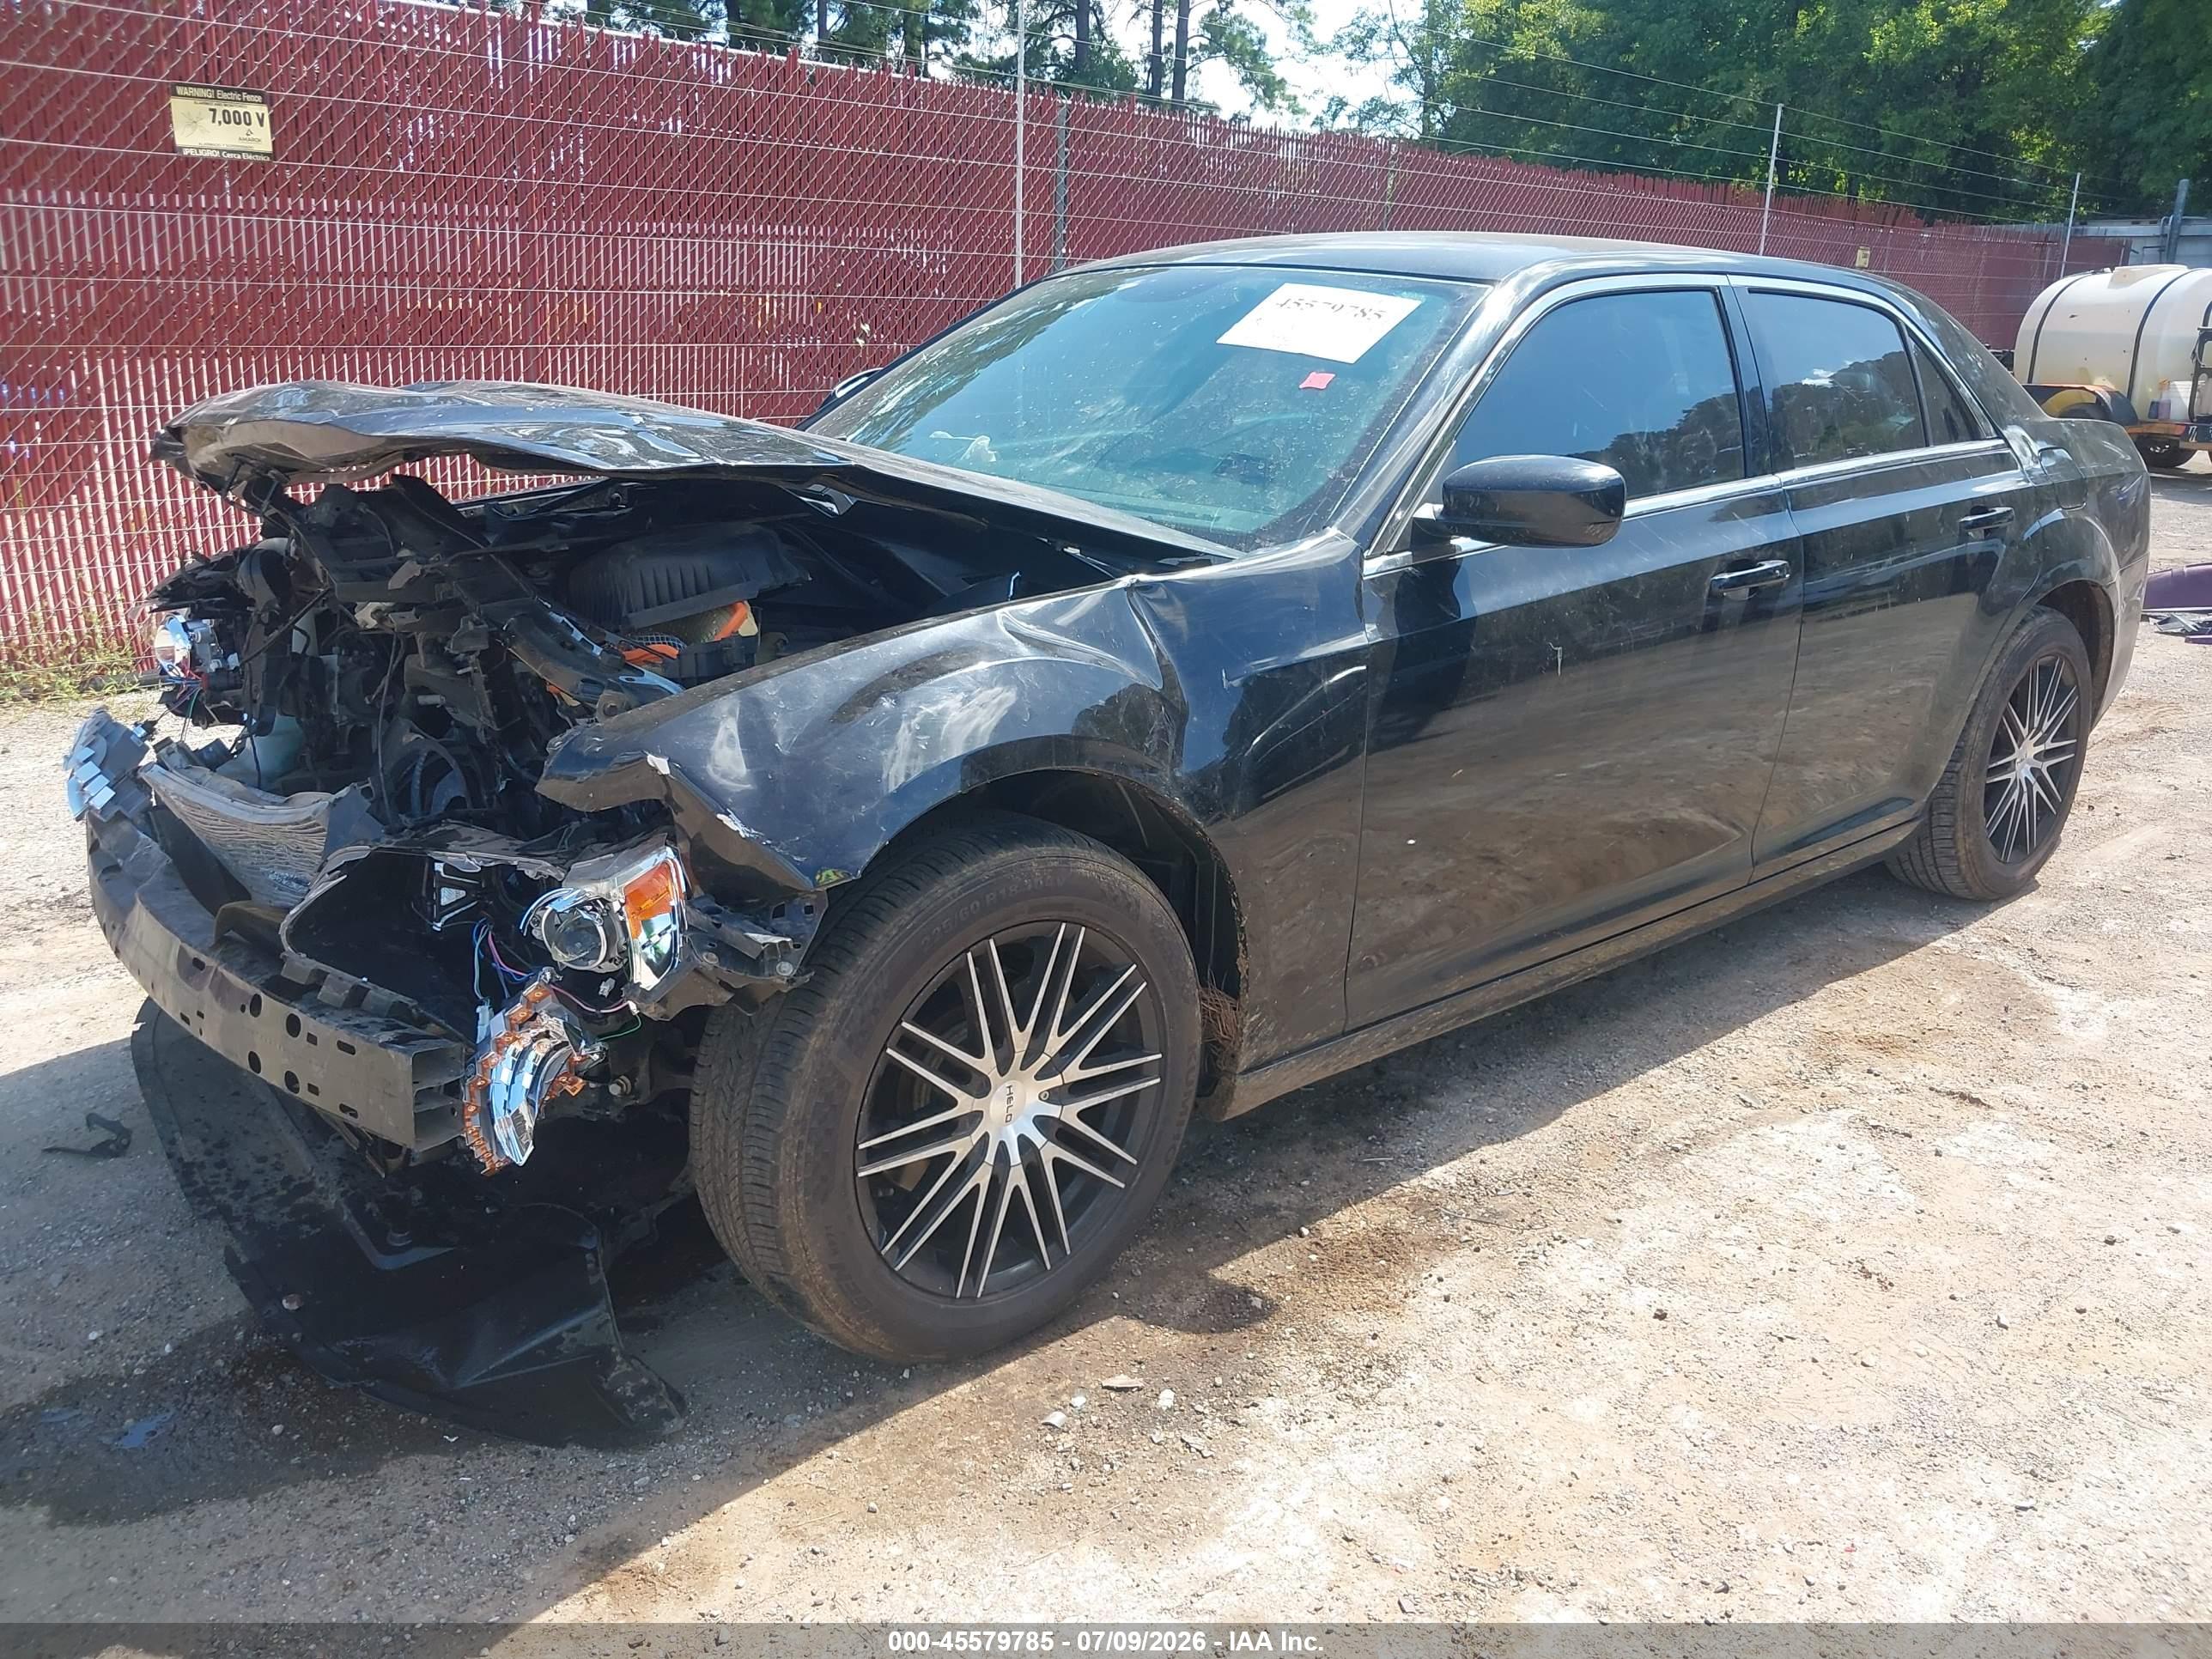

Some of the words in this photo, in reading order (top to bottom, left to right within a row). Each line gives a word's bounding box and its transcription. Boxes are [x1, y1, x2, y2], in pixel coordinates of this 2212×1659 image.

[176, 86, 215, 99] WARNING!
[216, 89, 241, 100] Electric
[243, 92, 263, 103] Fence
[209, 107, 252, 127] 7,000
[256, 112, 264, 128] V
[222, 151, 241, 160] Cerca
[1005, 1084, 1014, 1124] HELO
